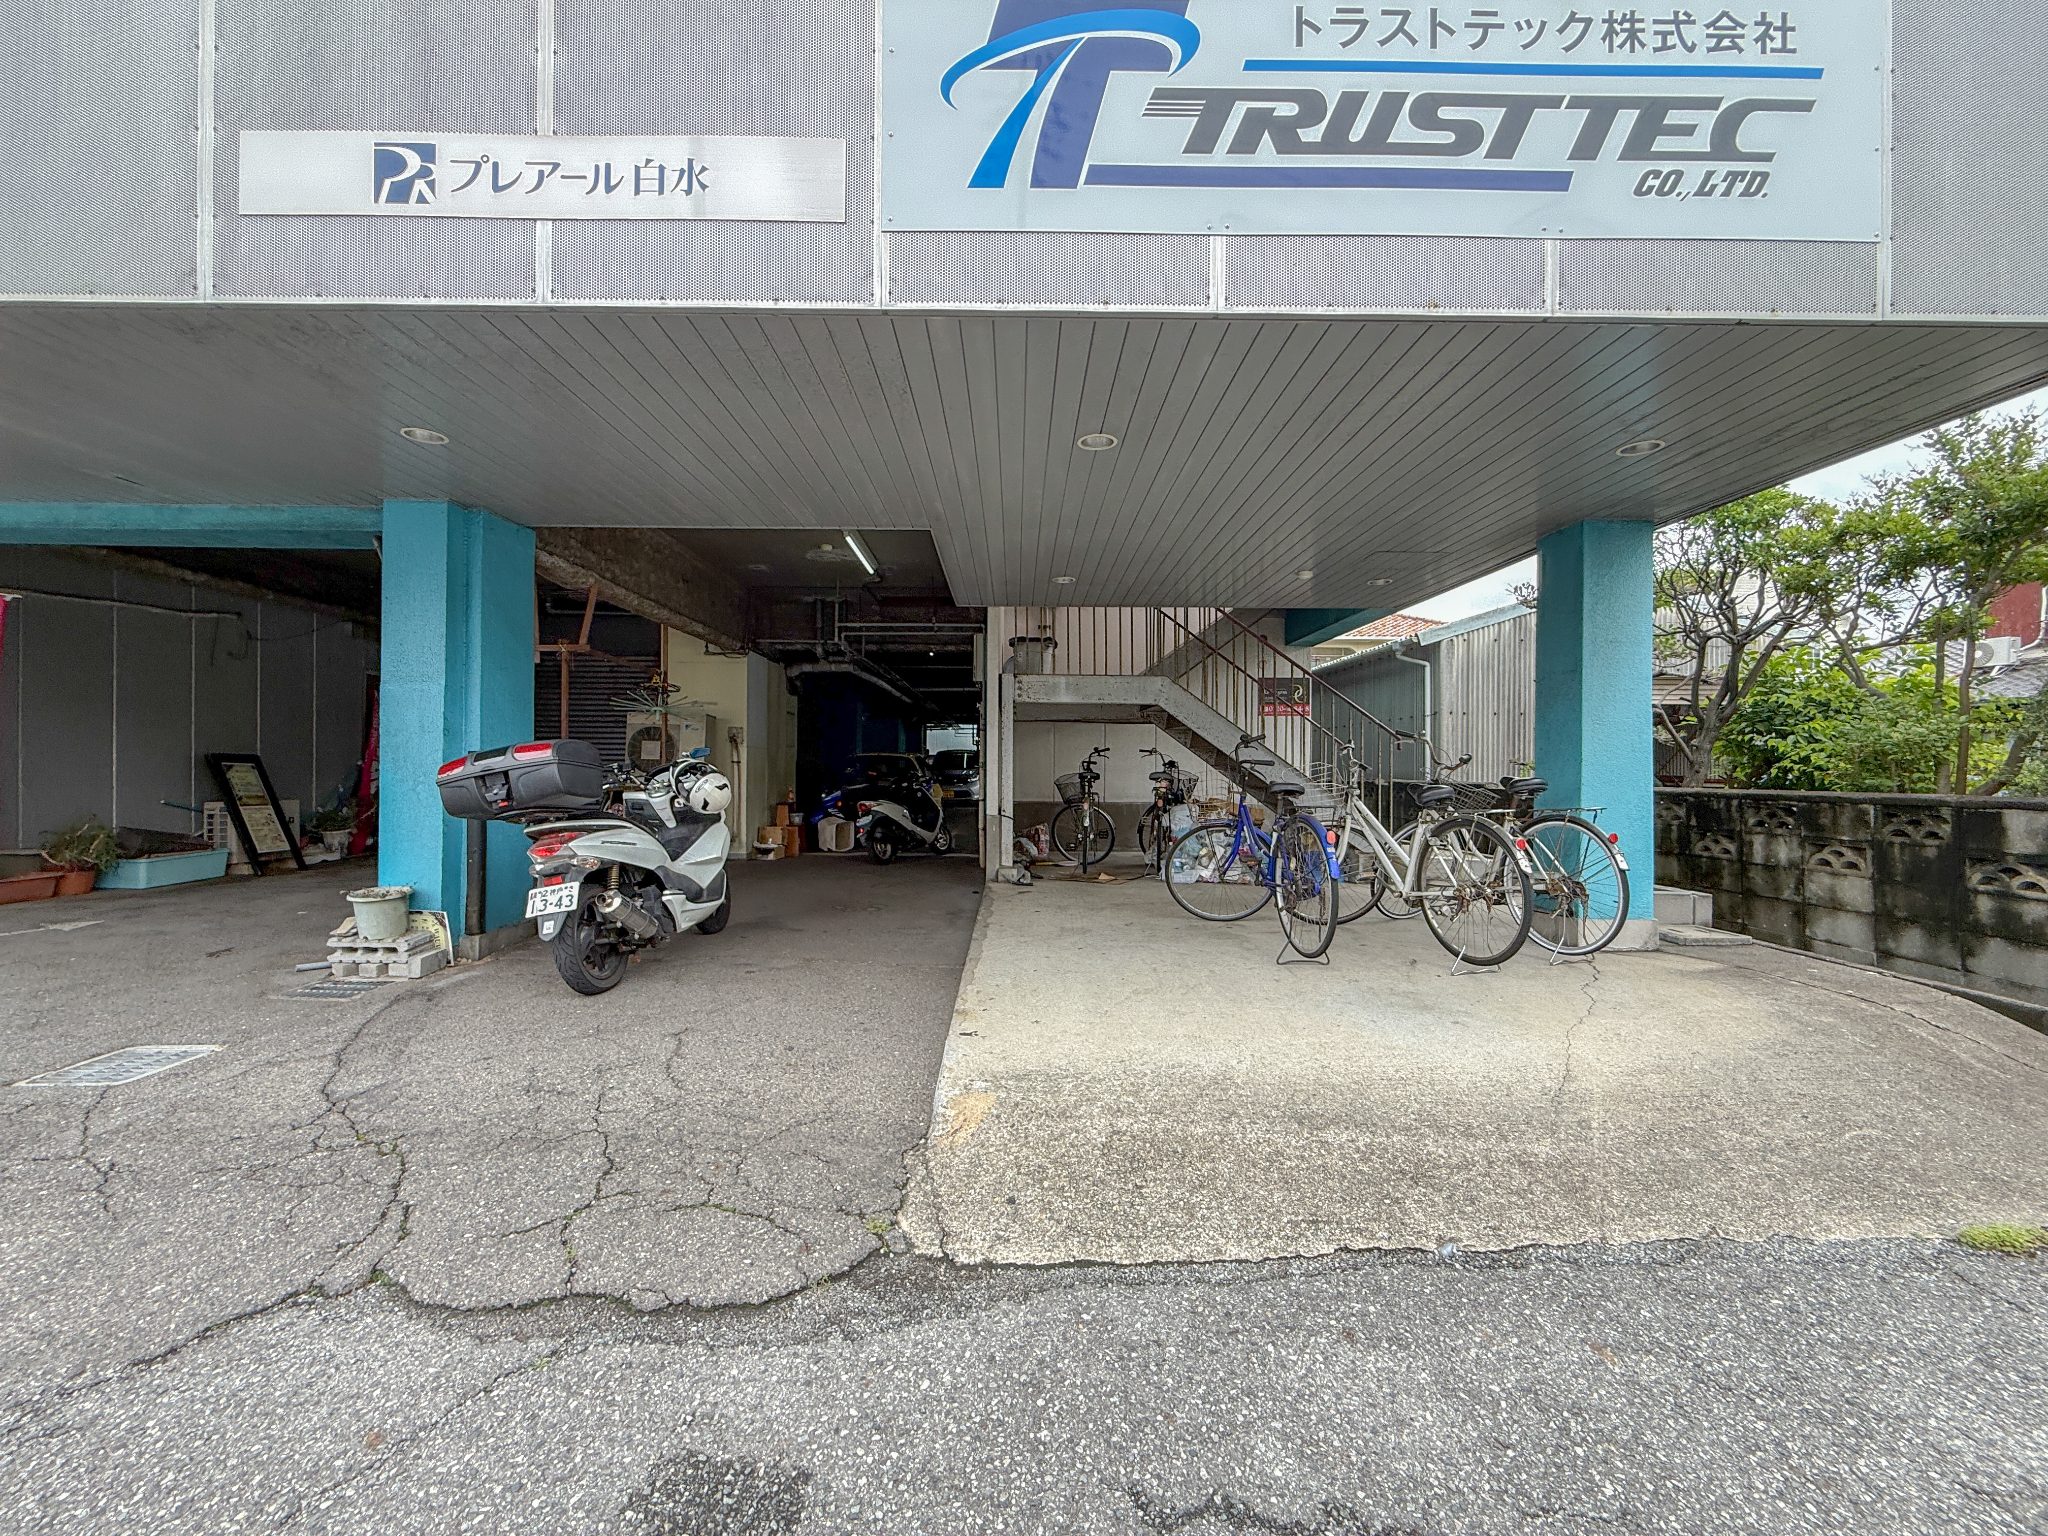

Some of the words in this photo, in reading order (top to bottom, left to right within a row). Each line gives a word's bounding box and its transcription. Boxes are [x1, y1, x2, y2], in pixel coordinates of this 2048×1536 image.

[1295, 5, 1797, 54] トラストテック株式会社
[449, 154, 710, 196] プレアール白水
[530, 893, 574, 914] 13-43
